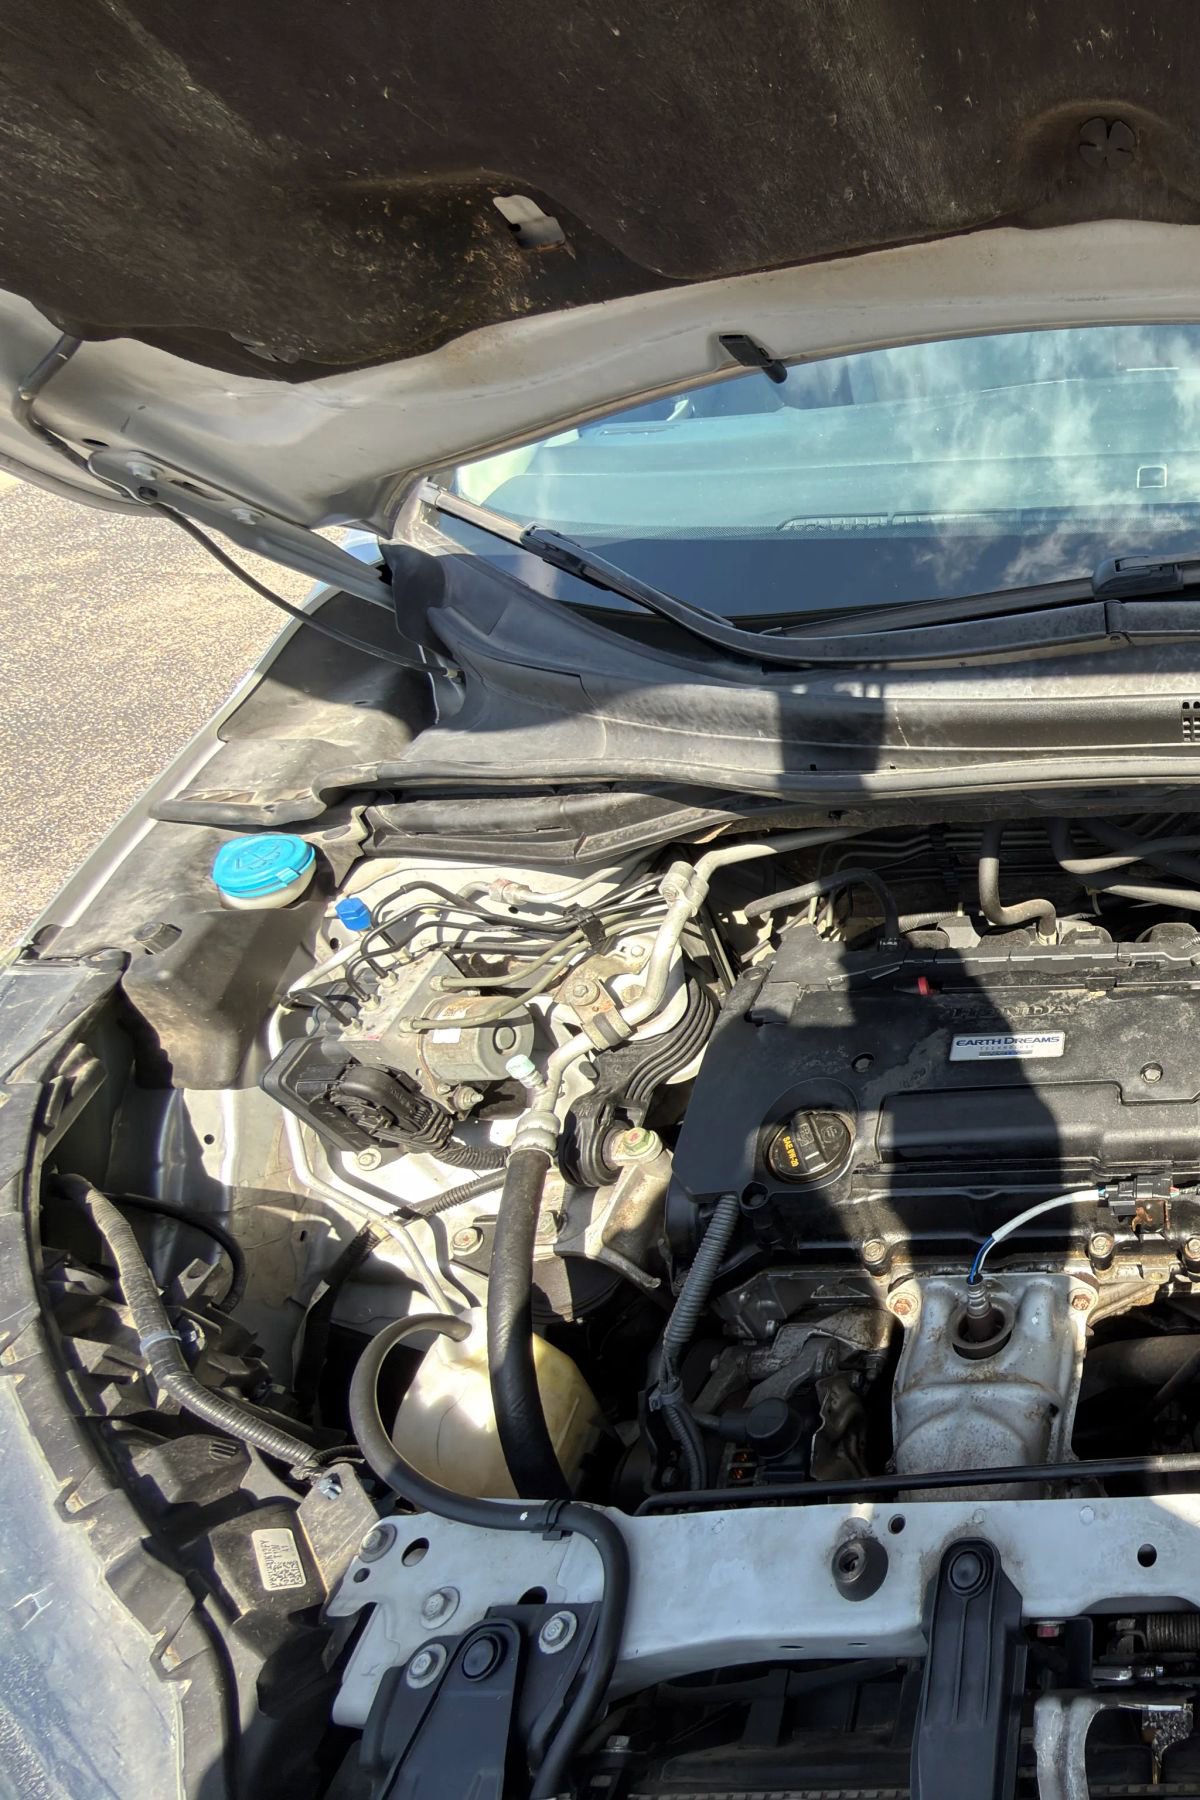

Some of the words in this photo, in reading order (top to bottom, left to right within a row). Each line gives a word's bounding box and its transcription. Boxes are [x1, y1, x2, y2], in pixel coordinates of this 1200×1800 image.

[956, 1038, 1002, 1047] EARTH
[1003, 1036, 1060, 1045] DREAMS
[783, 1136, 793, 1150] SAE
